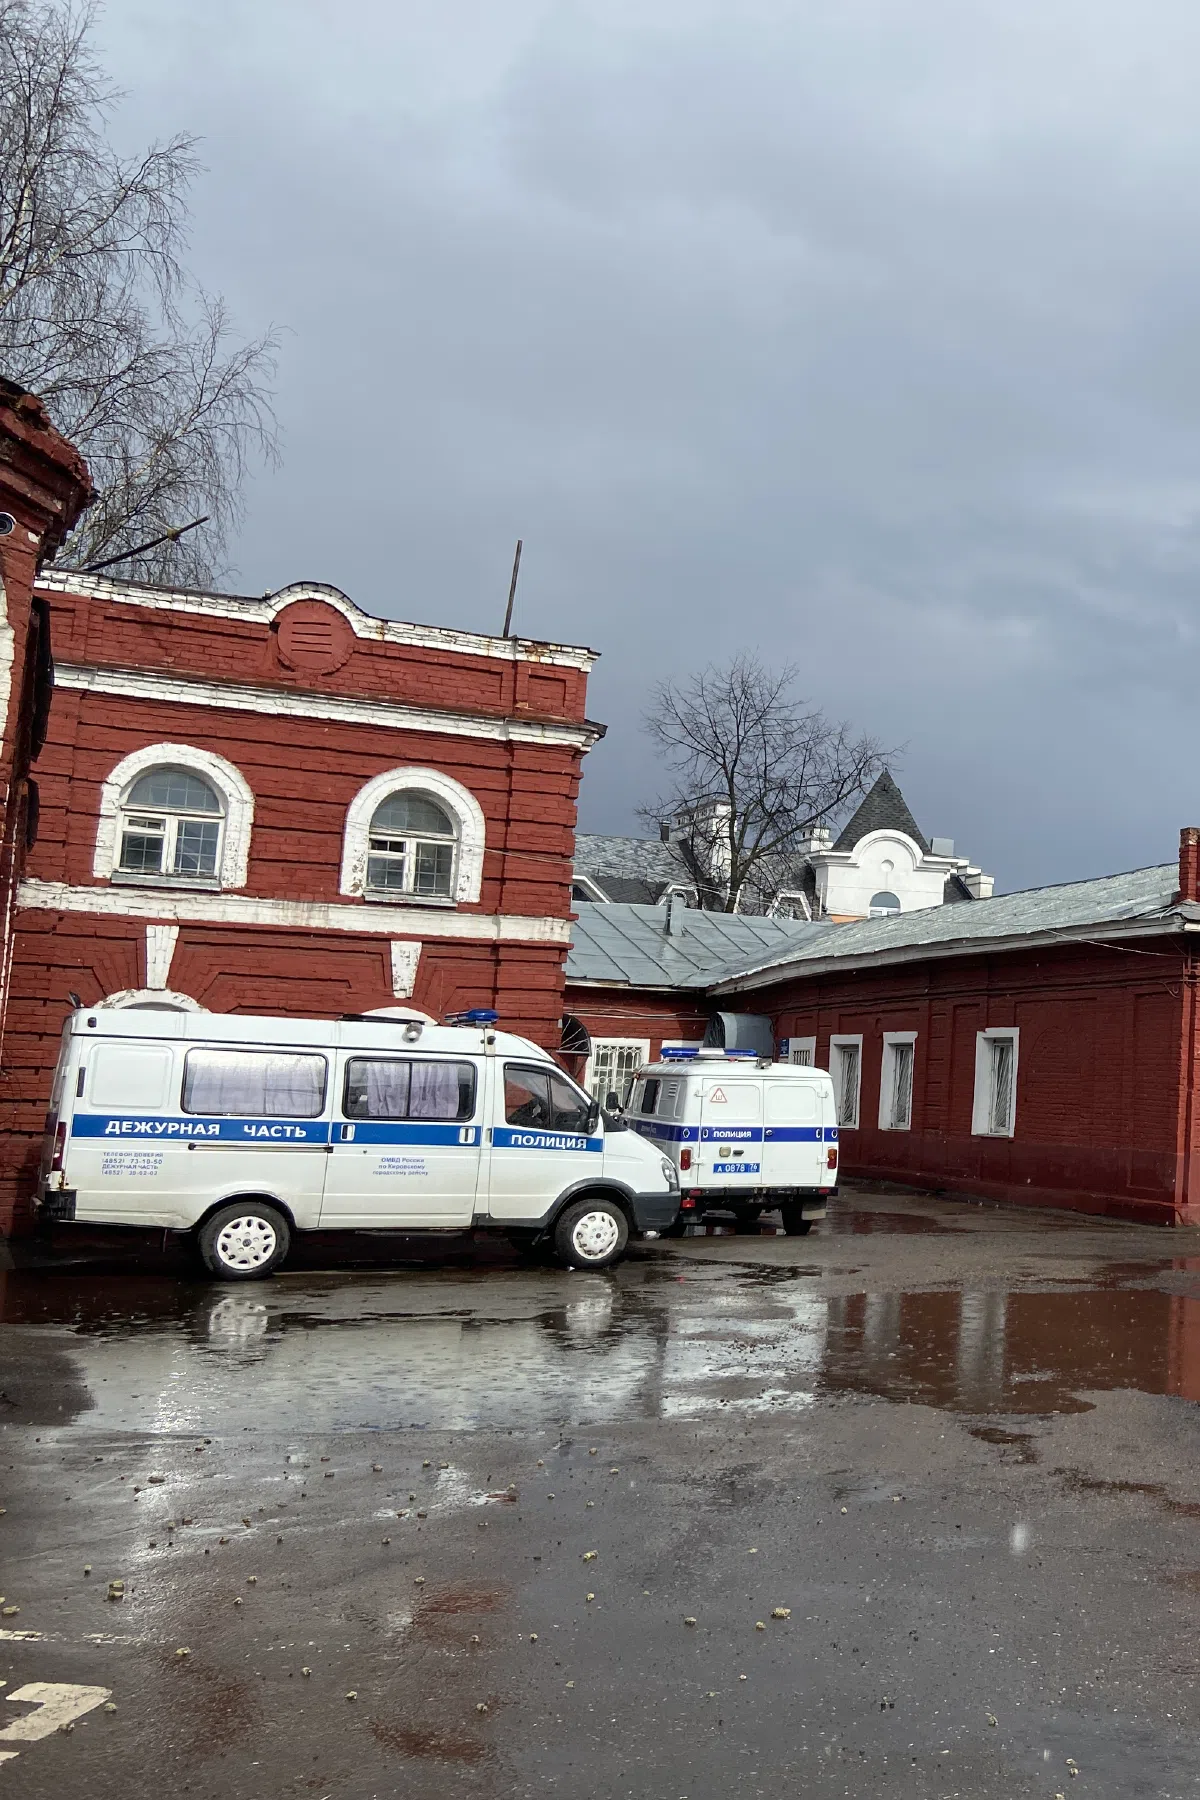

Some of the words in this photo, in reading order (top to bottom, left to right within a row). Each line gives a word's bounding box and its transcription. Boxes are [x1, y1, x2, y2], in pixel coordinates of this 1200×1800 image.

[105, 1120, 221, 1136] ДЕЖУРНАЯ
[243, 1124, 307, 1138] ЧАСТЬ
[713, 1130, 752, 1138] ПОЛИЦИЯ
[511, 1134, 587, 1150] ПОЛИЦИЯ
[725, 1164, 746, 1172] 0878
